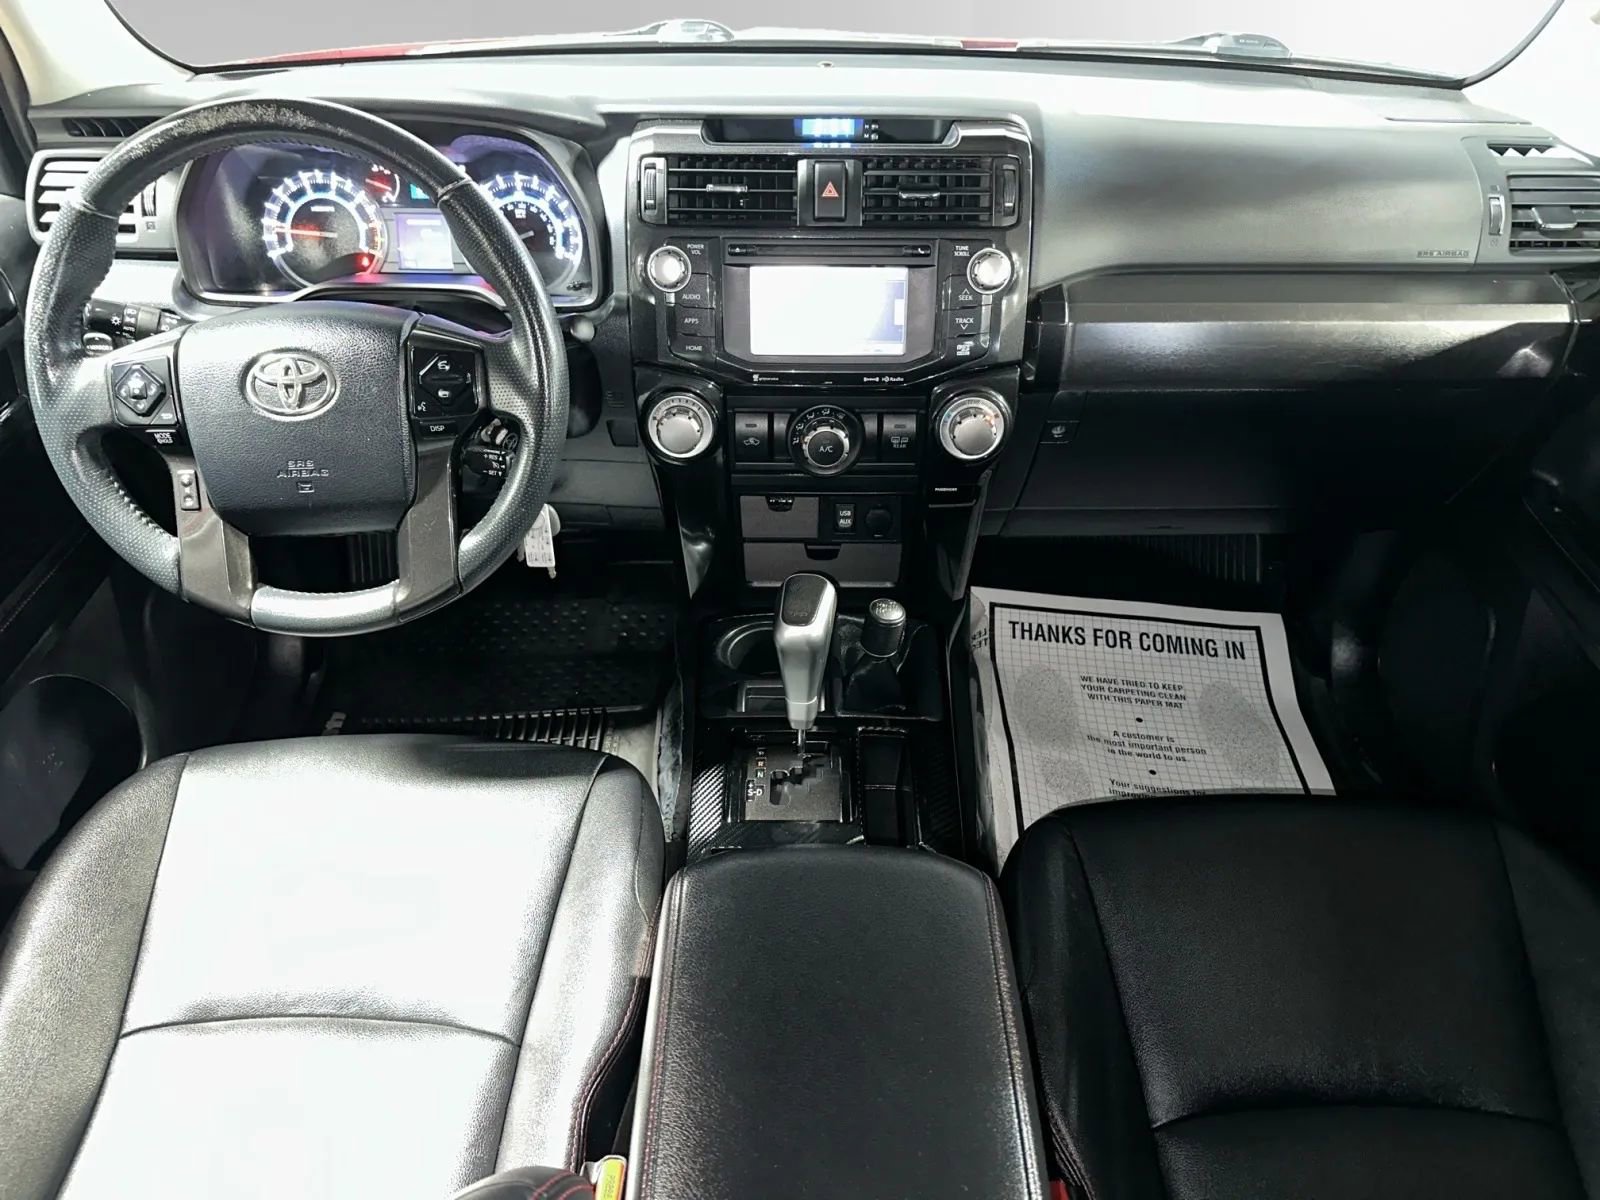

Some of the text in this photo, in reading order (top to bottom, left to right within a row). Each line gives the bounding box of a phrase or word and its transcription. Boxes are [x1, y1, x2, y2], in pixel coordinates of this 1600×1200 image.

[819, 445, 833, 453] A/C
[288, 460, 314, 468] SRS
[276, 469, 329, 479] AIRBAG
[1008, 620, 1086, 646] THANKS
[1093, 628, 1132, 650] FOR
[1139, 632, 1219, 658] COMING
[1224, 640, 1246, 660] IN
[1096, 676, 1119, 685] HAVE
[1121, 679, 1146, 688] TRIED
[1149, 681, 1160, 690] TO
[1161, 683, 1183, 692] KEEP
[1081, 684, 1186, 701] YOUR CARPETING CLEAN
[1088, 693, 1184, 709] WITH THIS PAPER MAT
[1121, 731, 1164, 741] customer
[1166, 735, 1175, 743] is
[1087, 734, 1207, 755] the most important person
[1118, 748, 1133, 757] the
[1135, 751, 1161, 760] world
[1109, 778, 1130, 788] Your
